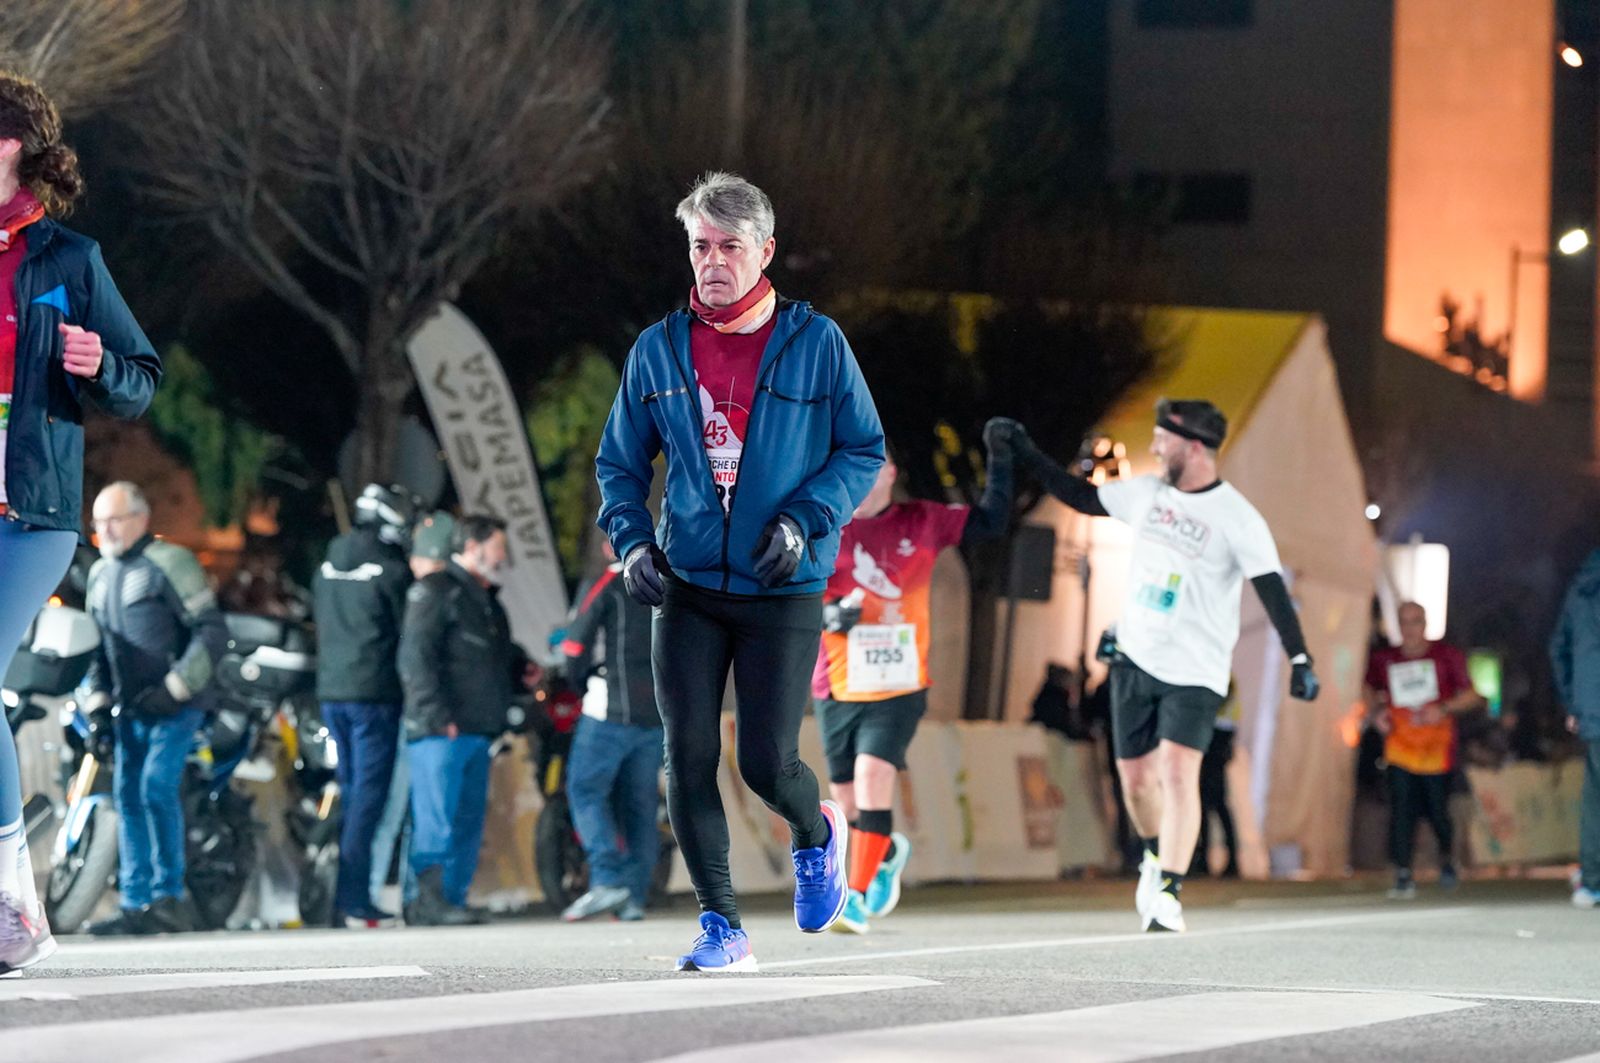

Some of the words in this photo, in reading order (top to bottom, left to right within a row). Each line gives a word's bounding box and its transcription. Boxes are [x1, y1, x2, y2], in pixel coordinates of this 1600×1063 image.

[704, 420, 728, 446] 43
[710, 460, 728, 470] CHE
[715, 470, 736, 482] NTÓ
